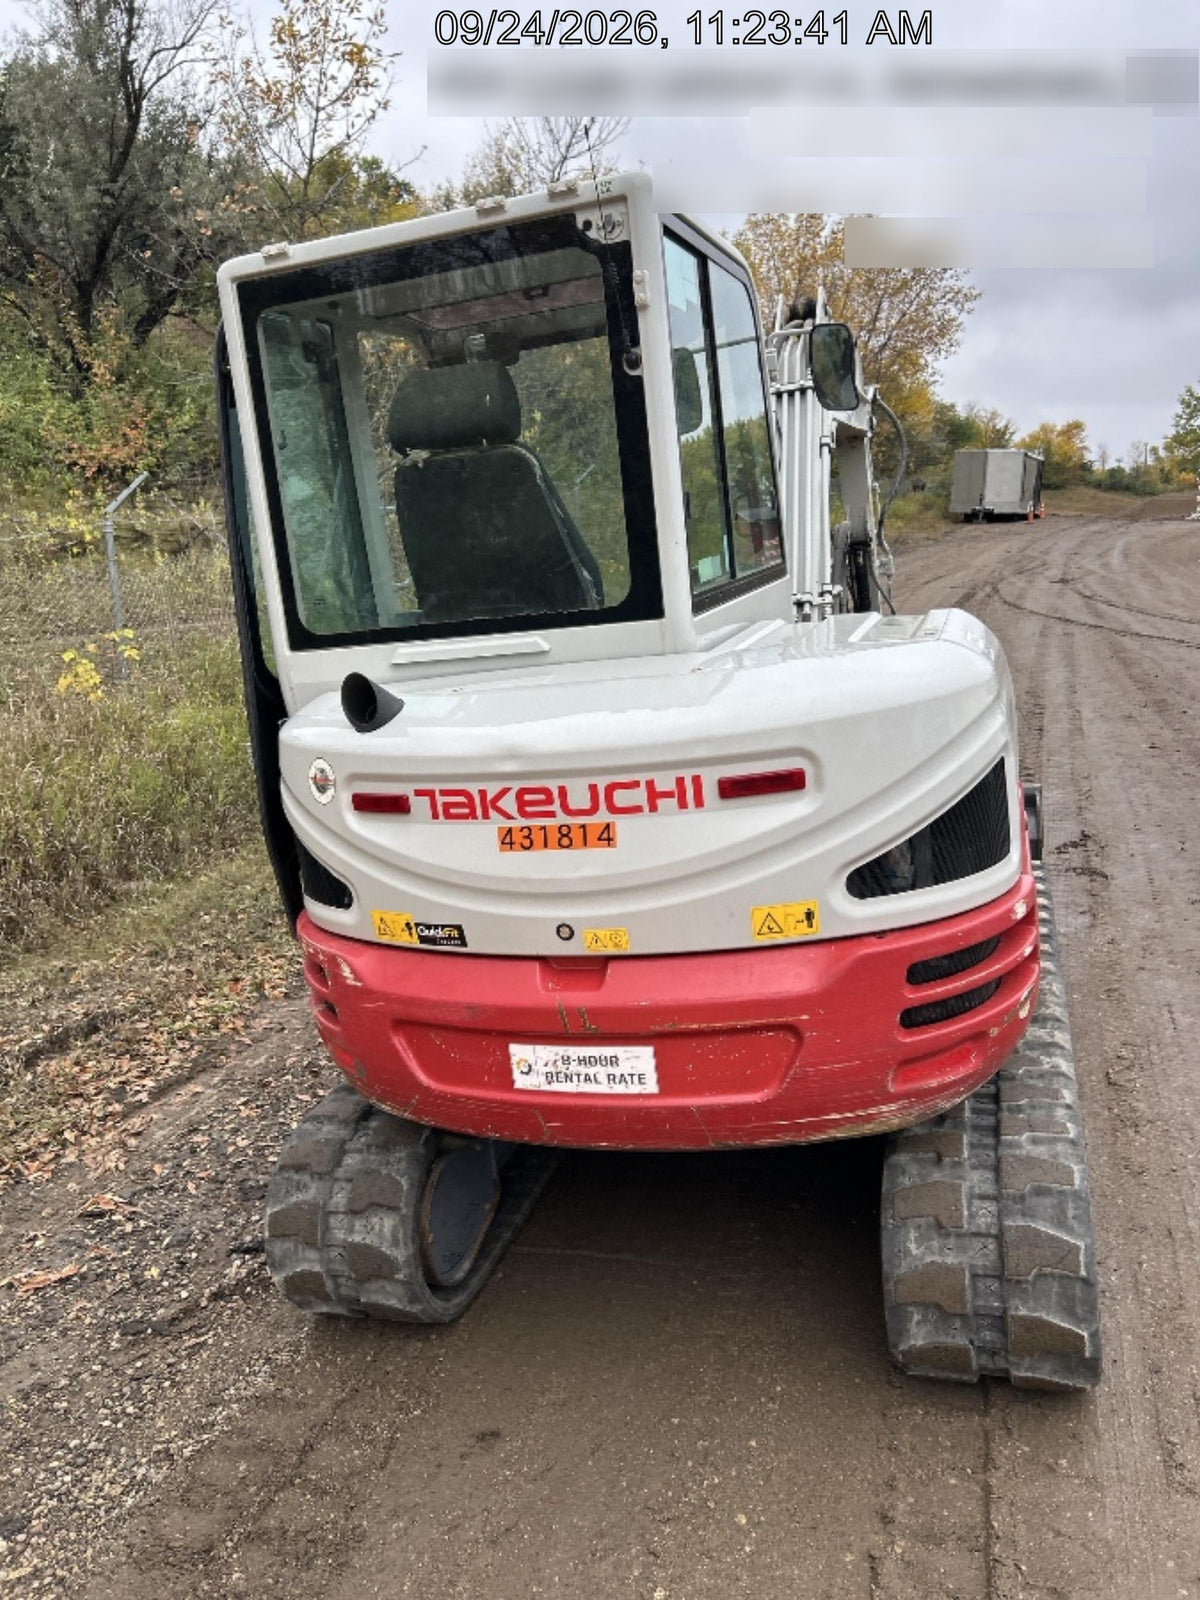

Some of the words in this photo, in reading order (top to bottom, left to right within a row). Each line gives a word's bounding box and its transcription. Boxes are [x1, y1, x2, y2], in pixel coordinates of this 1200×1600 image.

[413, 774, 705, 821] TAKEUCHI
[499, 822, 615, 850] 431814
[545, 1071, 602, 1085] RENTAL
[607, 1073, 647, 1086] RATE
